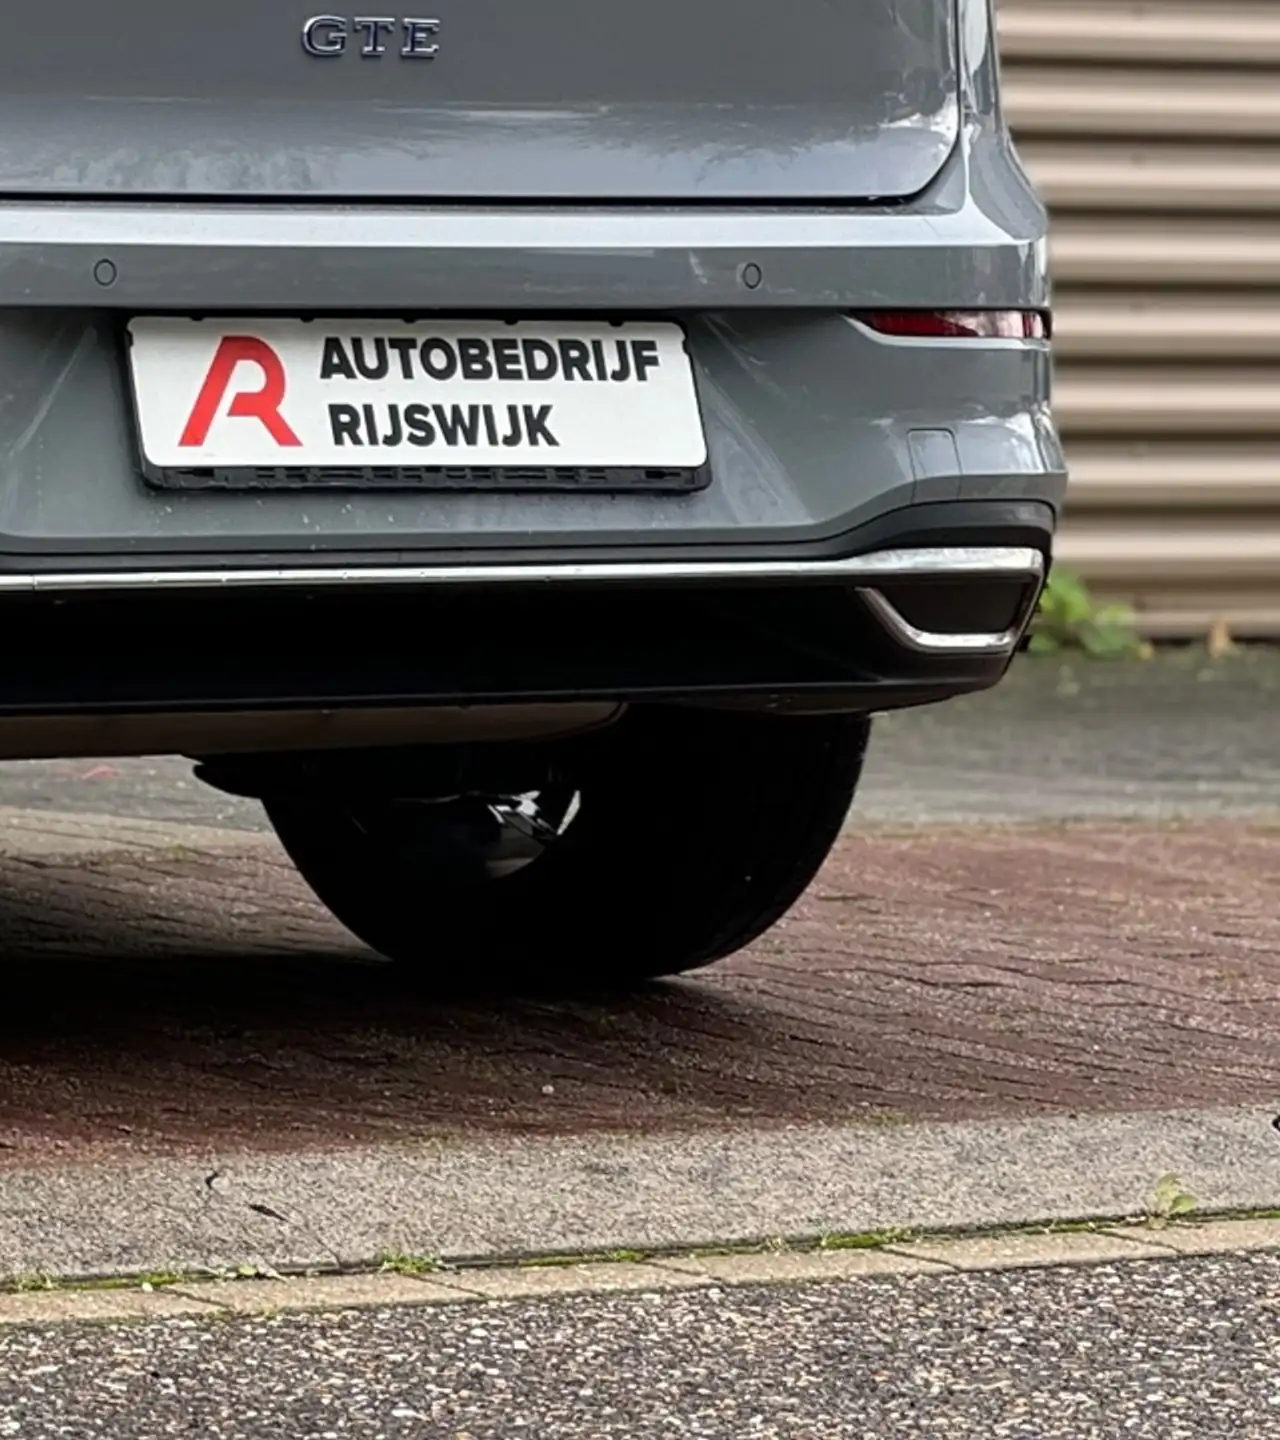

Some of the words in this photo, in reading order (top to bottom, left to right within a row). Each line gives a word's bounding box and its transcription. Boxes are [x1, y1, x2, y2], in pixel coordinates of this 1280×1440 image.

[301, 14, 440, 58] GTE
[320, 335, 659, 382] AUTOBEDRIJF
[327, 403, 560, 447] RIJSWIJK
